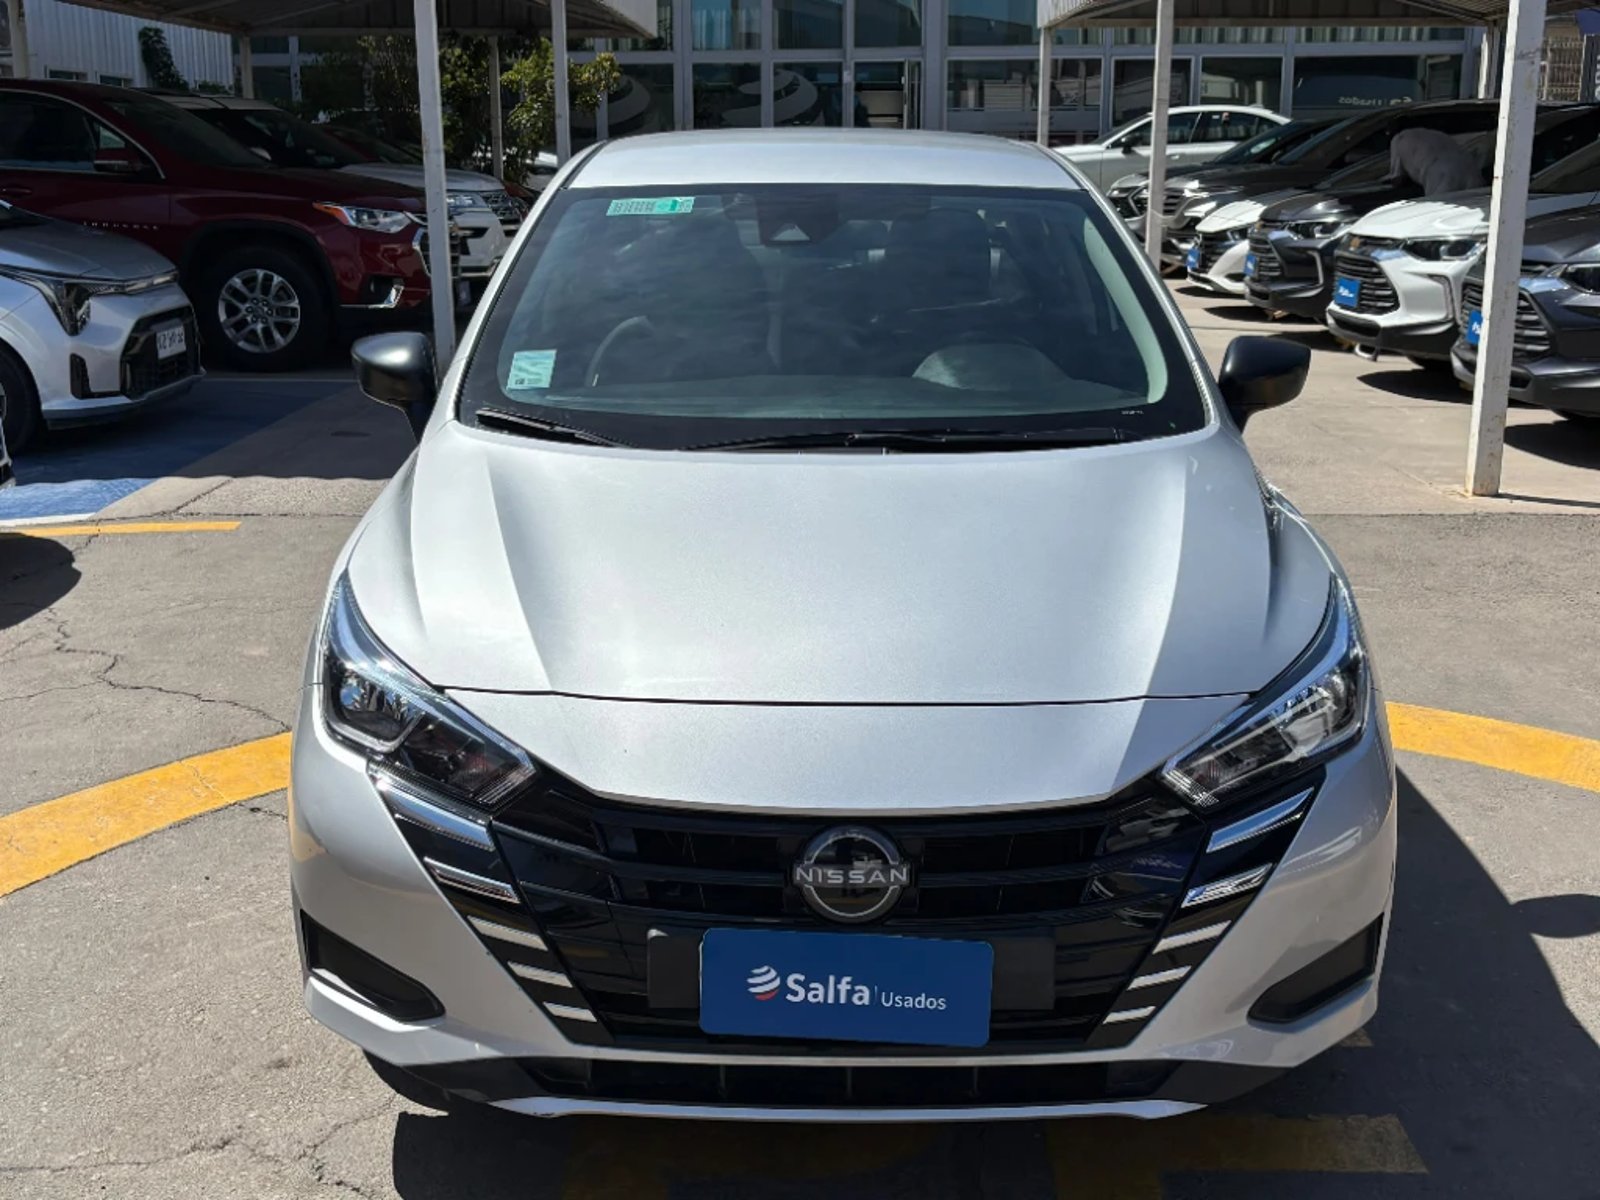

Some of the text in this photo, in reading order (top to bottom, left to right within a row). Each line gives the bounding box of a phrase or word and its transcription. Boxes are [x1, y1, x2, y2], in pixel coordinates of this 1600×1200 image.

[796, 867, 907, 884] NISSAN
[785, 973, 947, 1011] Salfa Usados
